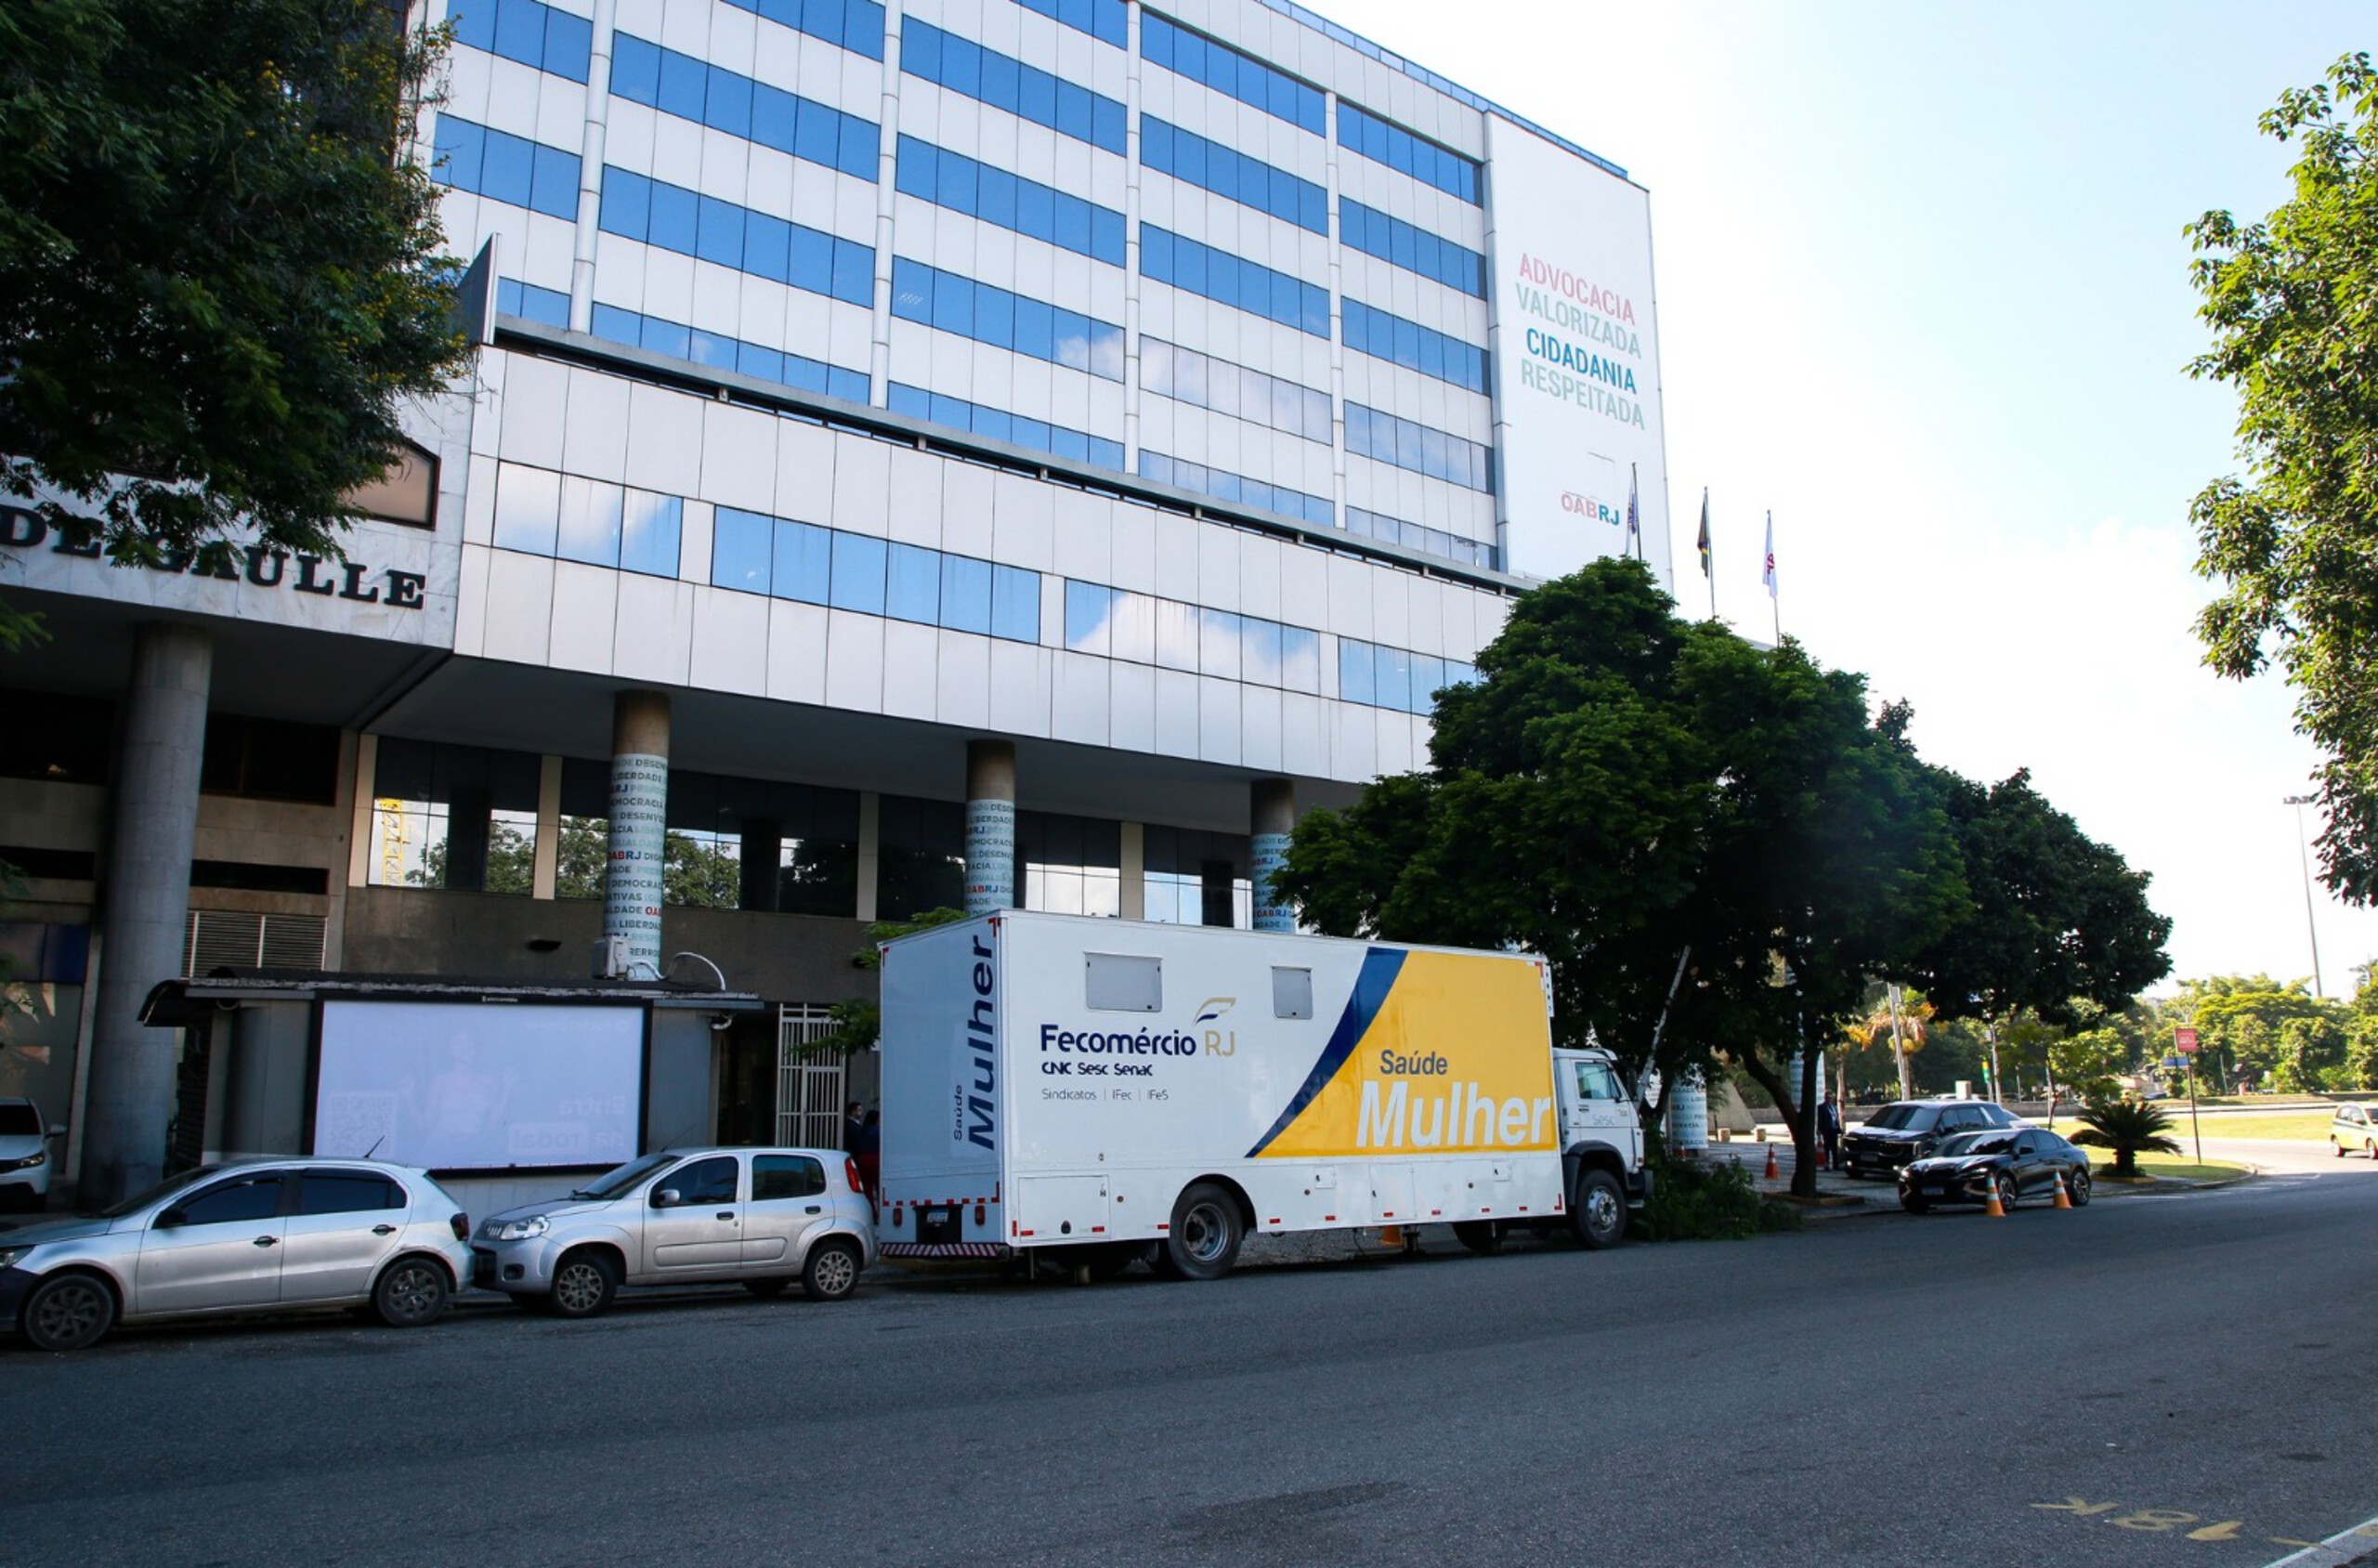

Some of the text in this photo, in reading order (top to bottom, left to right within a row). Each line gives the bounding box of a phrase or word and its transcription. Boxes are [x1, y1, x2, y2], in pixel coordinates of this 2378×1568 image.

[1519, 253, 1635, 325] ADVOCACIA
[1516, 282, 1641, 359] VALORIZADA
[1526, 328, 1637, 394] CIDADANIA
[1521, 359, 1645, 430] RESPEITADA
[0, 504, 103, 559] DE
[1561, 492, 1620, 526] OABRJ
[967, 934, 995, 1151] Mulher
[1040, 1024, 1235, 1057] Fecomércio RJ
[1379, 1049, 1448, 1076] Saúde
[1041, 1062, 1153, 1077] CNC Sesc Senac
[1041, 1088, 1097, 1101] Sindicatos
[953, 1083, 962, 1142] Saúde
[1355, 1079, 1551, 1148] Mulher
[1592, 1114, 1615, 1126] Sesc
